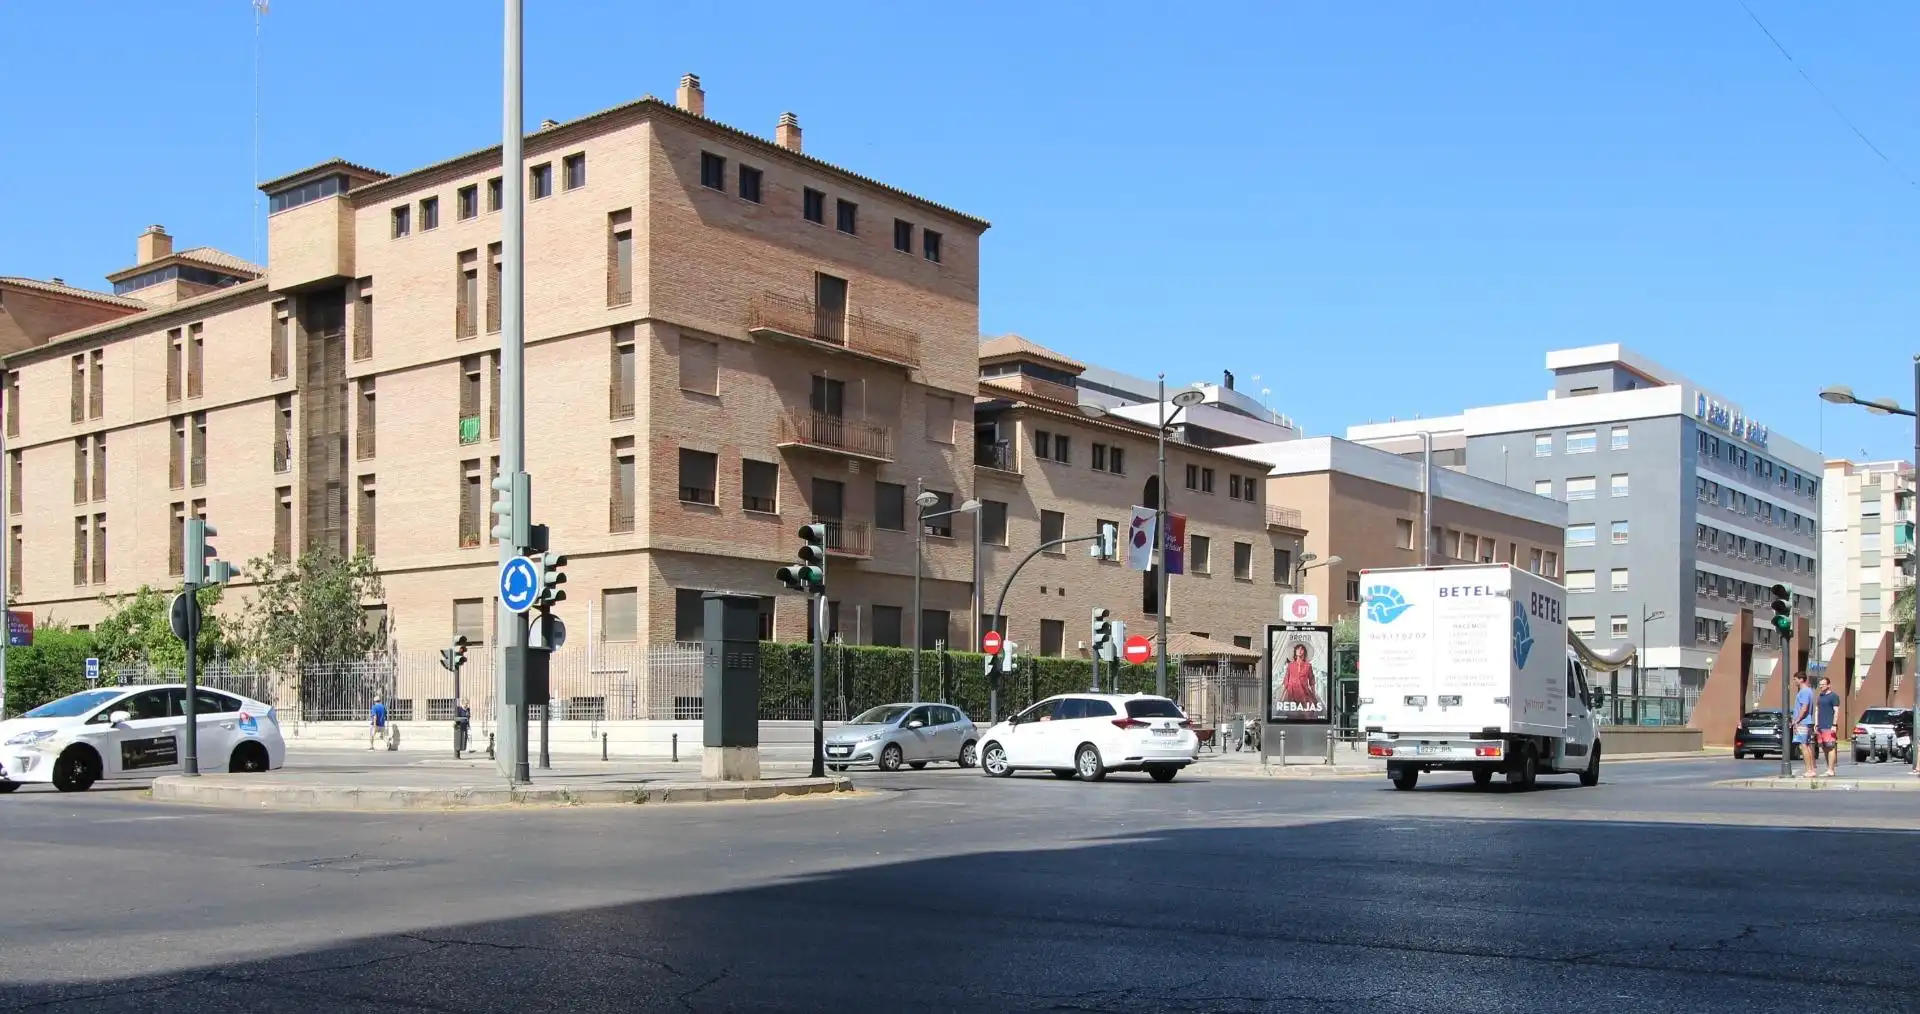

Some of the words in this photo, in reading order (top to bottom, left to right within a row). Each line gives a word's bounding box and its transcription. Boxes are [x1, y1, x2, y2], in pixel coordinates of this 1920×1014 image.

[1439, 585, 1493, 598] BETEL
[1531, 592, 1562, 625] BETEL
[1289, 634, 1312, 642] arena
[1276, 701, 1323, 712] REBAJAS
